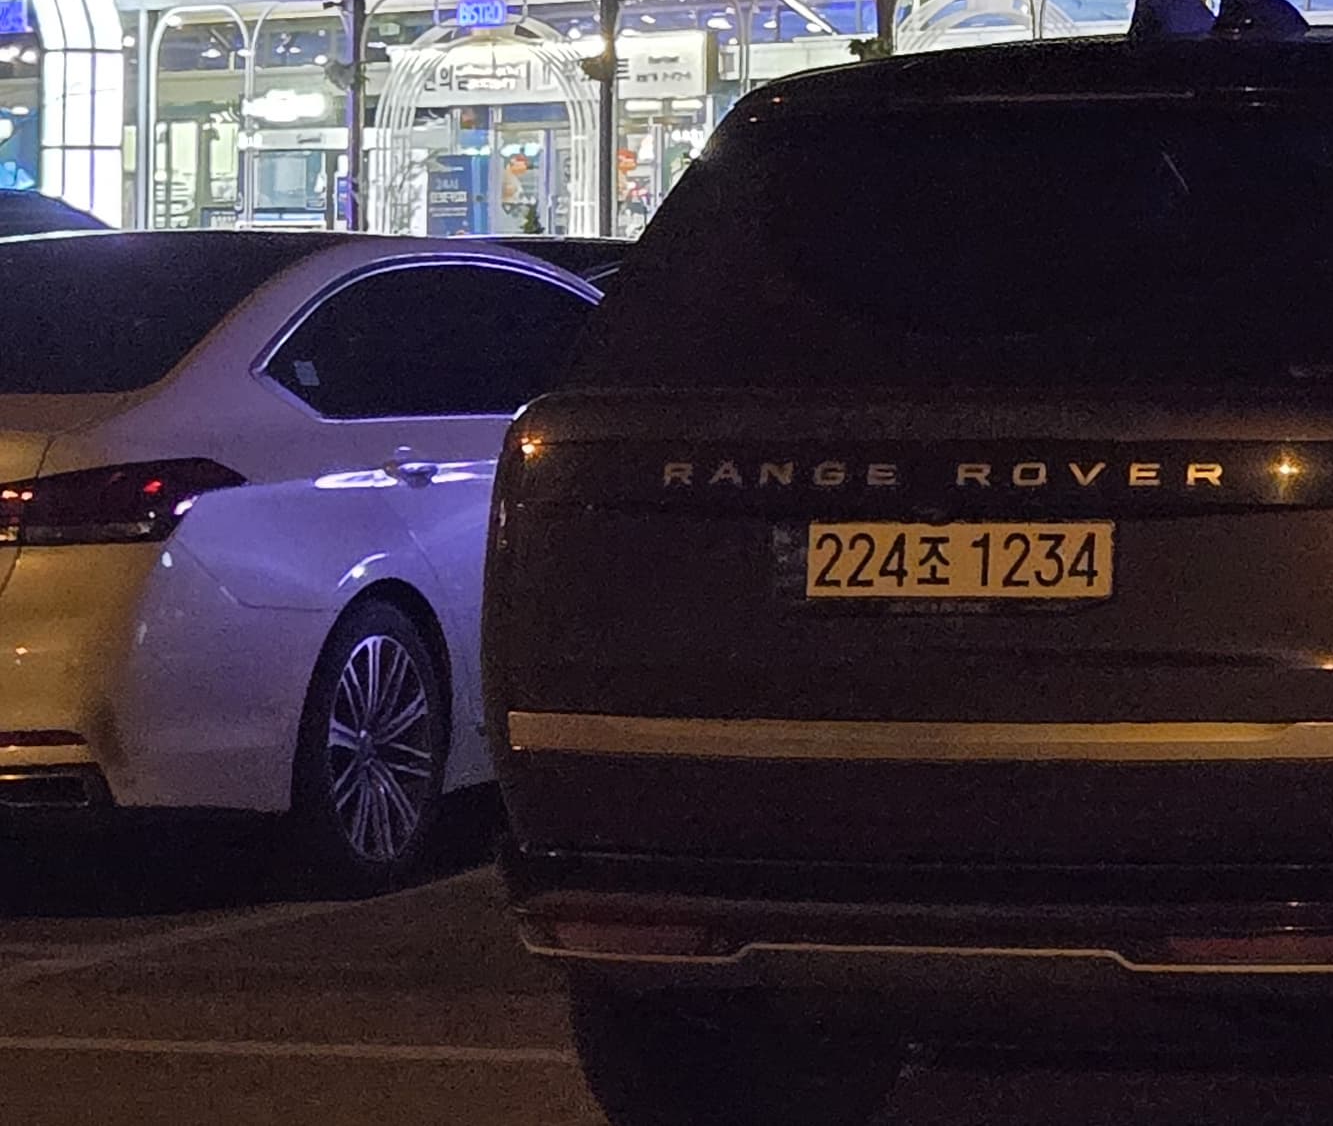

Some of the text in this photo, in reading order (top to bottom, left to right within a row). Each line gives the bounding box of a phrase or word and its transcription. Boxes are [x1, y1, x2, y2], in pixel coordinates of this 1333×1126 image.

[458, 0, 504, 26] BISTRO
[662, 460, 1224, 488] RANGE ROVER
[813, 531, 1099, 588] 224조 1234
